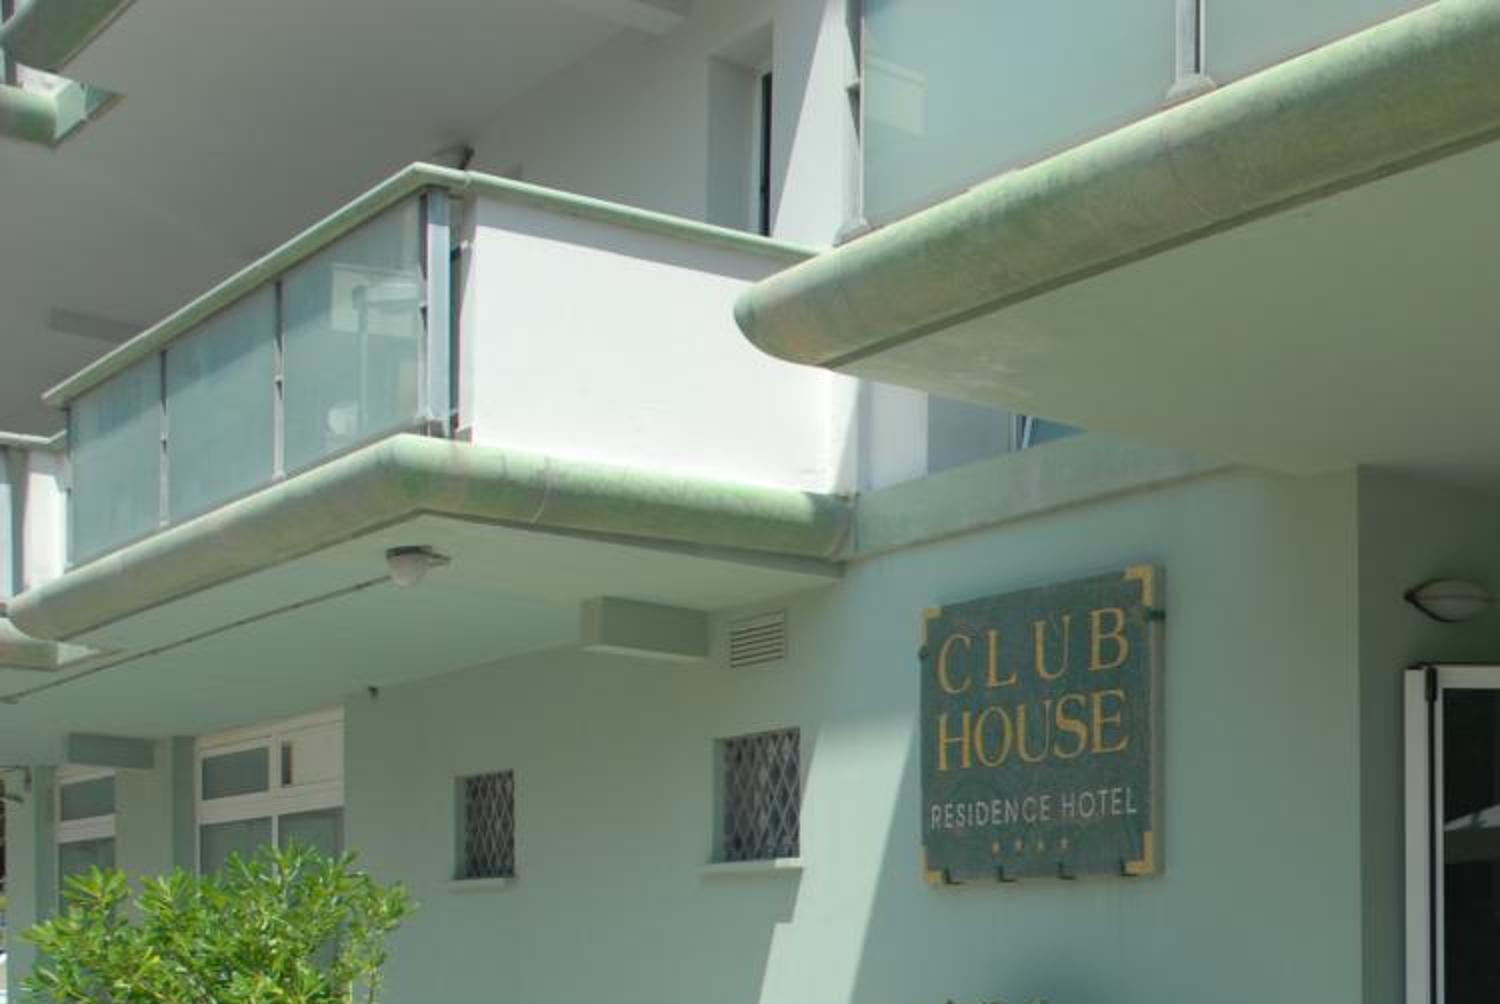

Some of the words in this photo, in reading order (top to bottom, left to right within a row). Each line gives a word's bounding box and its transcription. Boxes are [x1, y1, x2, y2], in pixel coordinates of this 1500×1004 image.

[936, 607, 1130, 695] CLUB
[936, 689, 1129, 771] HOUSE
[930, 795, 1051, 830] RESIDENCE
[1061, 787, 1137, 817] HOTEL
